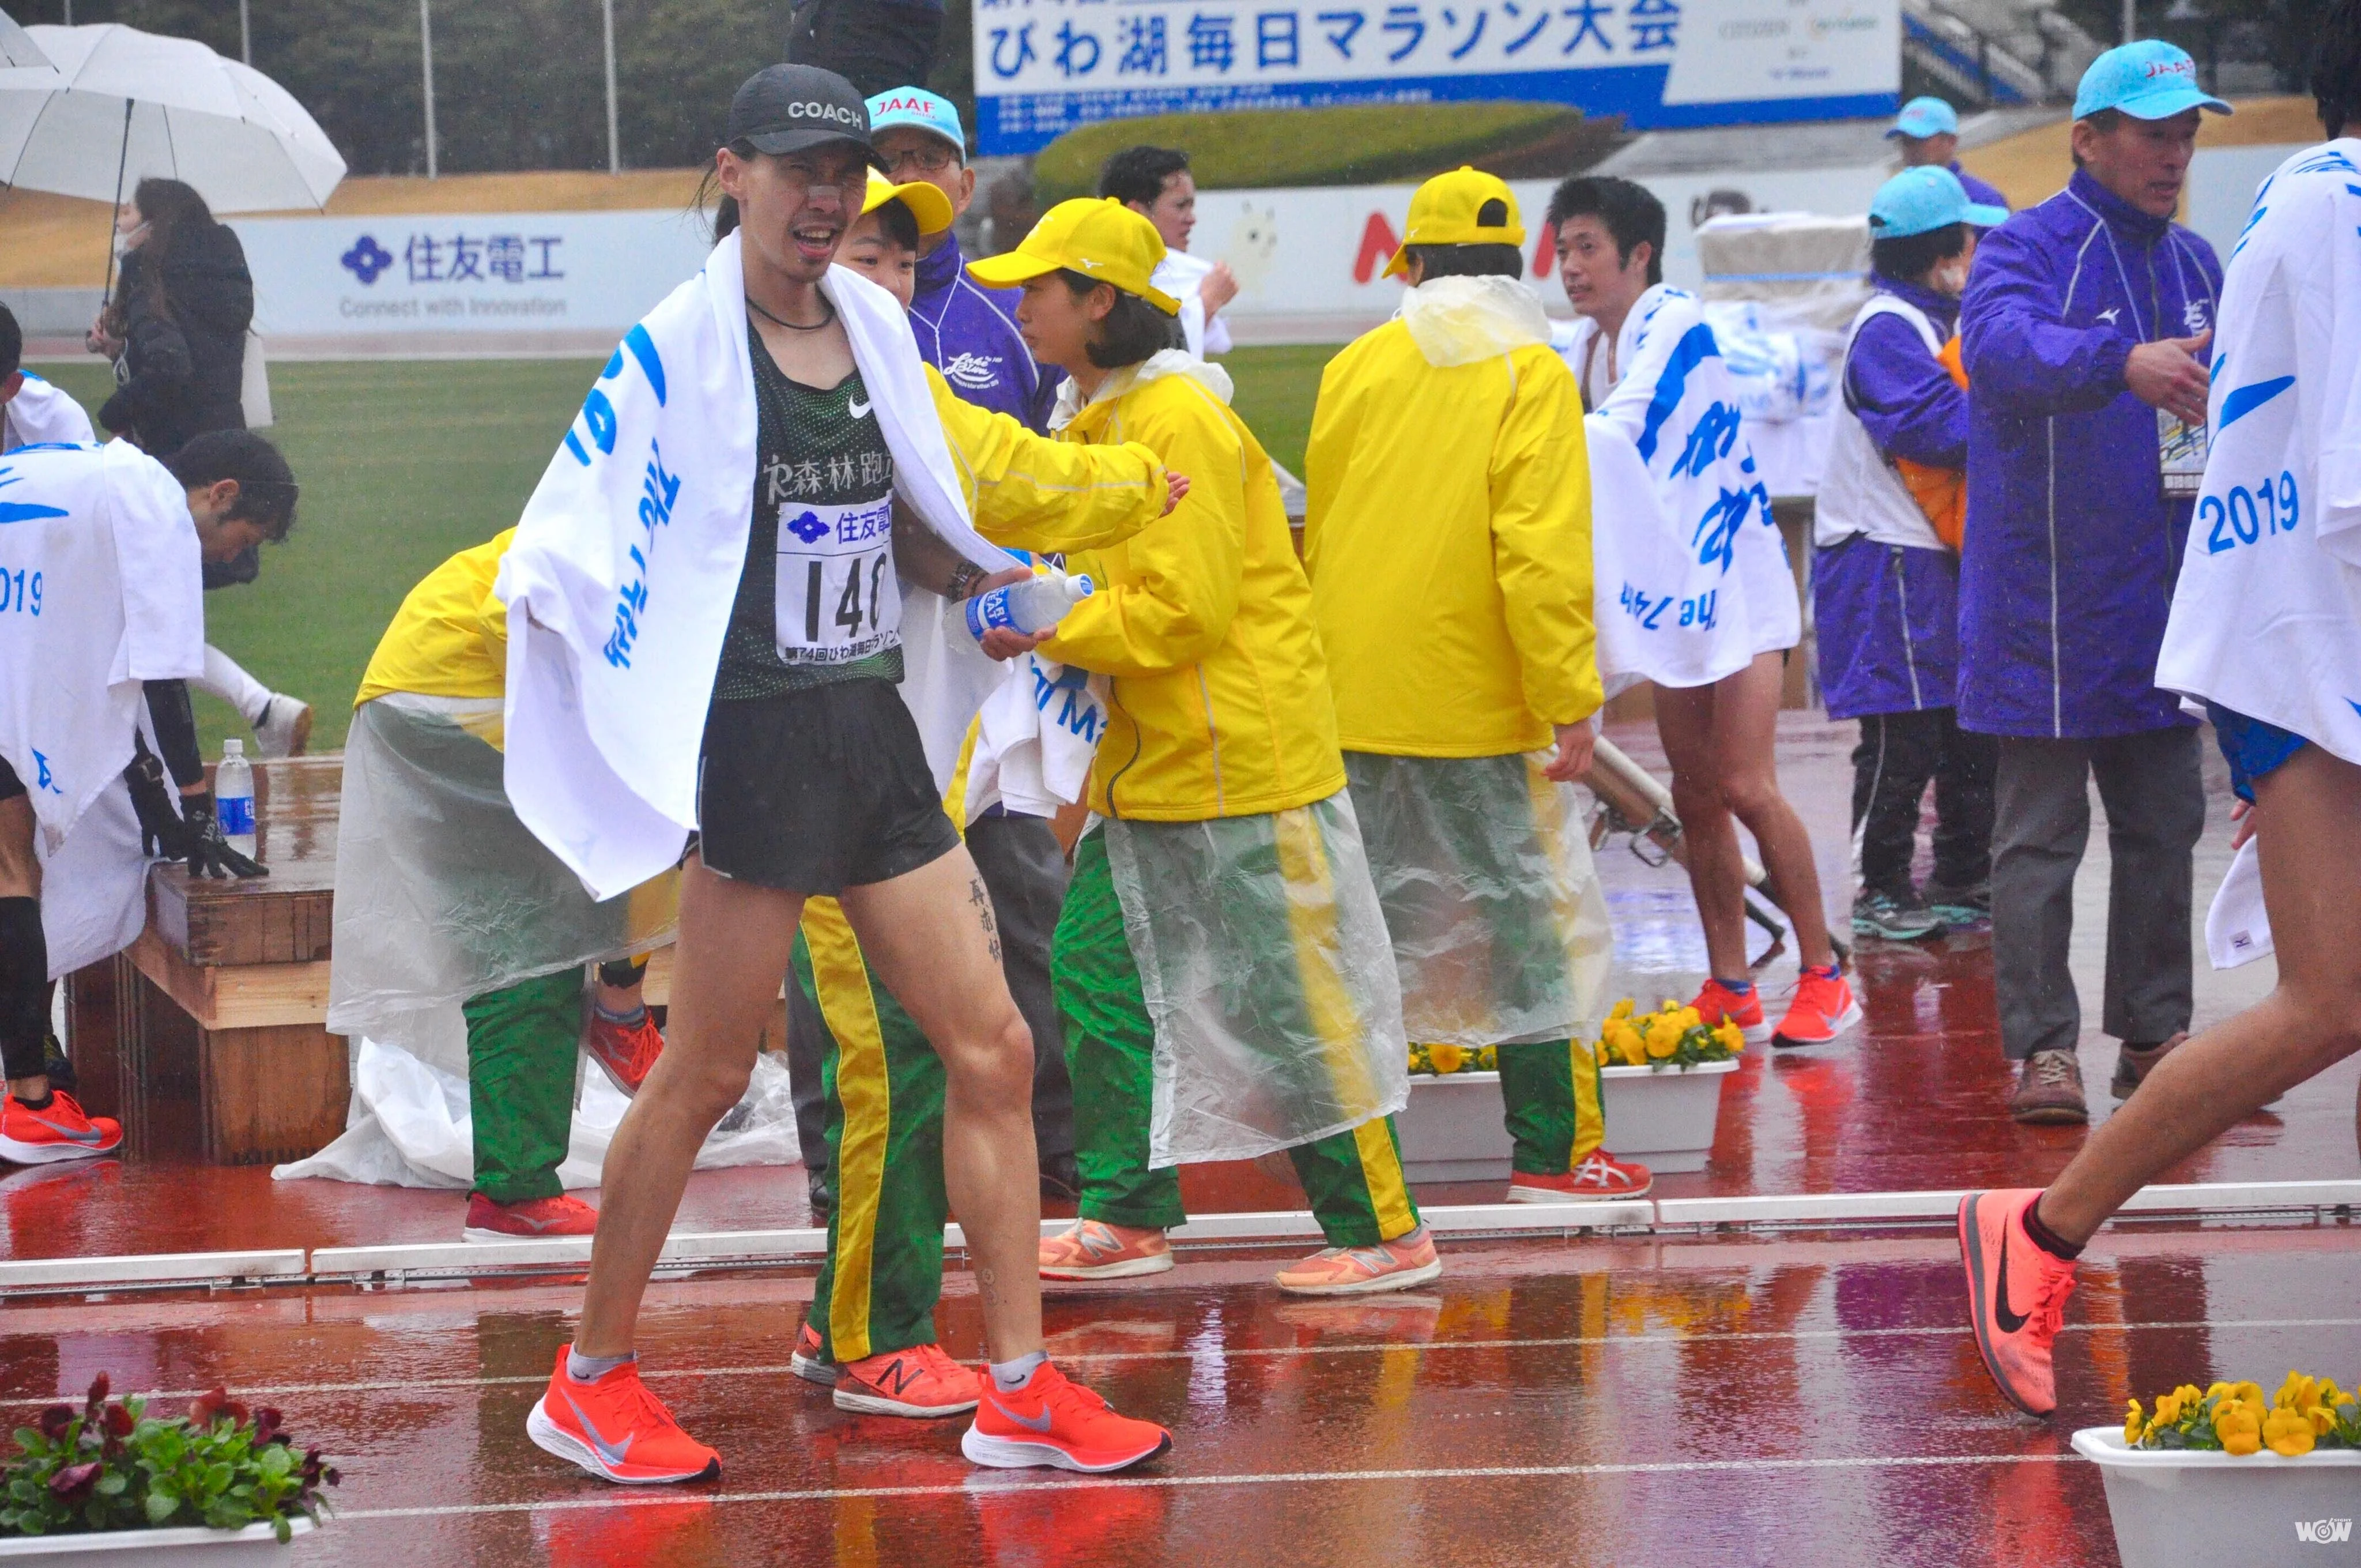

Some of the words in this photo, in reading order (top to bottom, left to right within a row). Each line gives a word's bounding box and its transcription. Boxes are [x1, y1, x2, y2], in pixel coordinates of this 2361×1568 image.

[988, 0, 1680, 78] びわ湖毎日マラソン大会
[788, 101, 863, 130] COACH
[874, 97, 936, 116] JAAF
[405, 233, 565, 284] 住友電工
[836, 500, 892, 544] 住友電
[2199, 470, 2299, 555] 2019
[805, 553, 887, 642] 140
